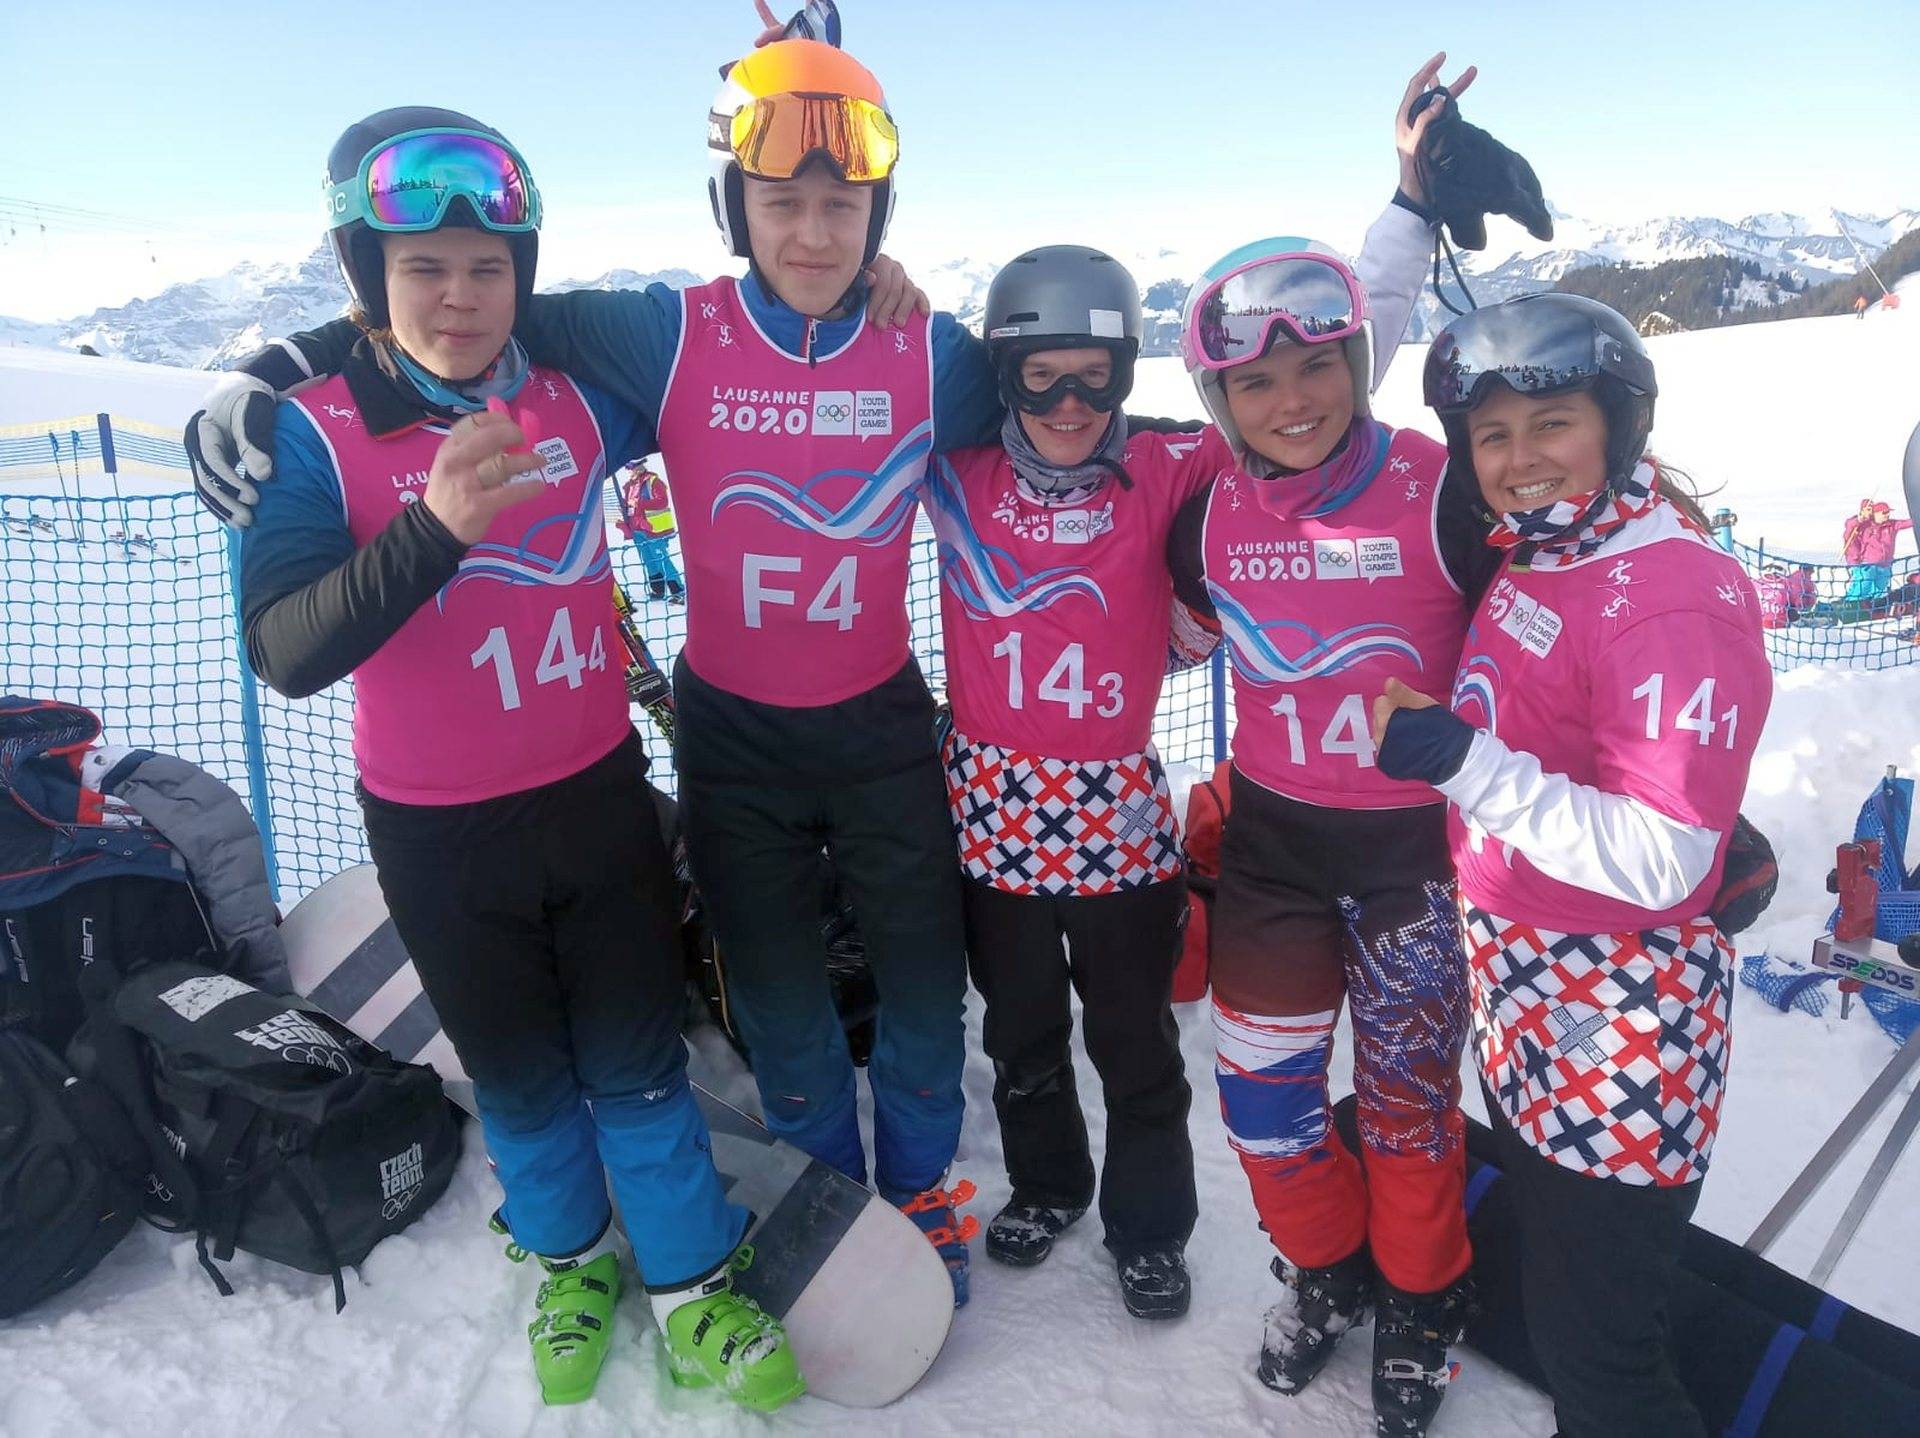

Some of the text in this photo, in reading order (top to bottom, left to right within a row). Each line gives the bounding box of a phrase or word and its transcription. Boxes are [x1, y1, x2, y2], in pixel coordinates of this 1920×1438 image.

[713, 385, 810, 405] LAUSANNE
[861, 396, 887, 406] YOUTH
[708, 402, 807, 435] 2020
[857, 408, 890, 418] OLYMPIC
[860, 419, 888, 429] GAMES
[1227, 541, 1310, 556] LAUSANNE
[1363, 543, 1393, 552] YOUTH
[1360, 553, 1398, 562] OLYMPIC
[1229, 556, 1312, 582] 2020
[1365, 563, 1396, 572] GAMES
[742, 553, 863, 632] F4
[1269, 693, 1378, 769] 14
